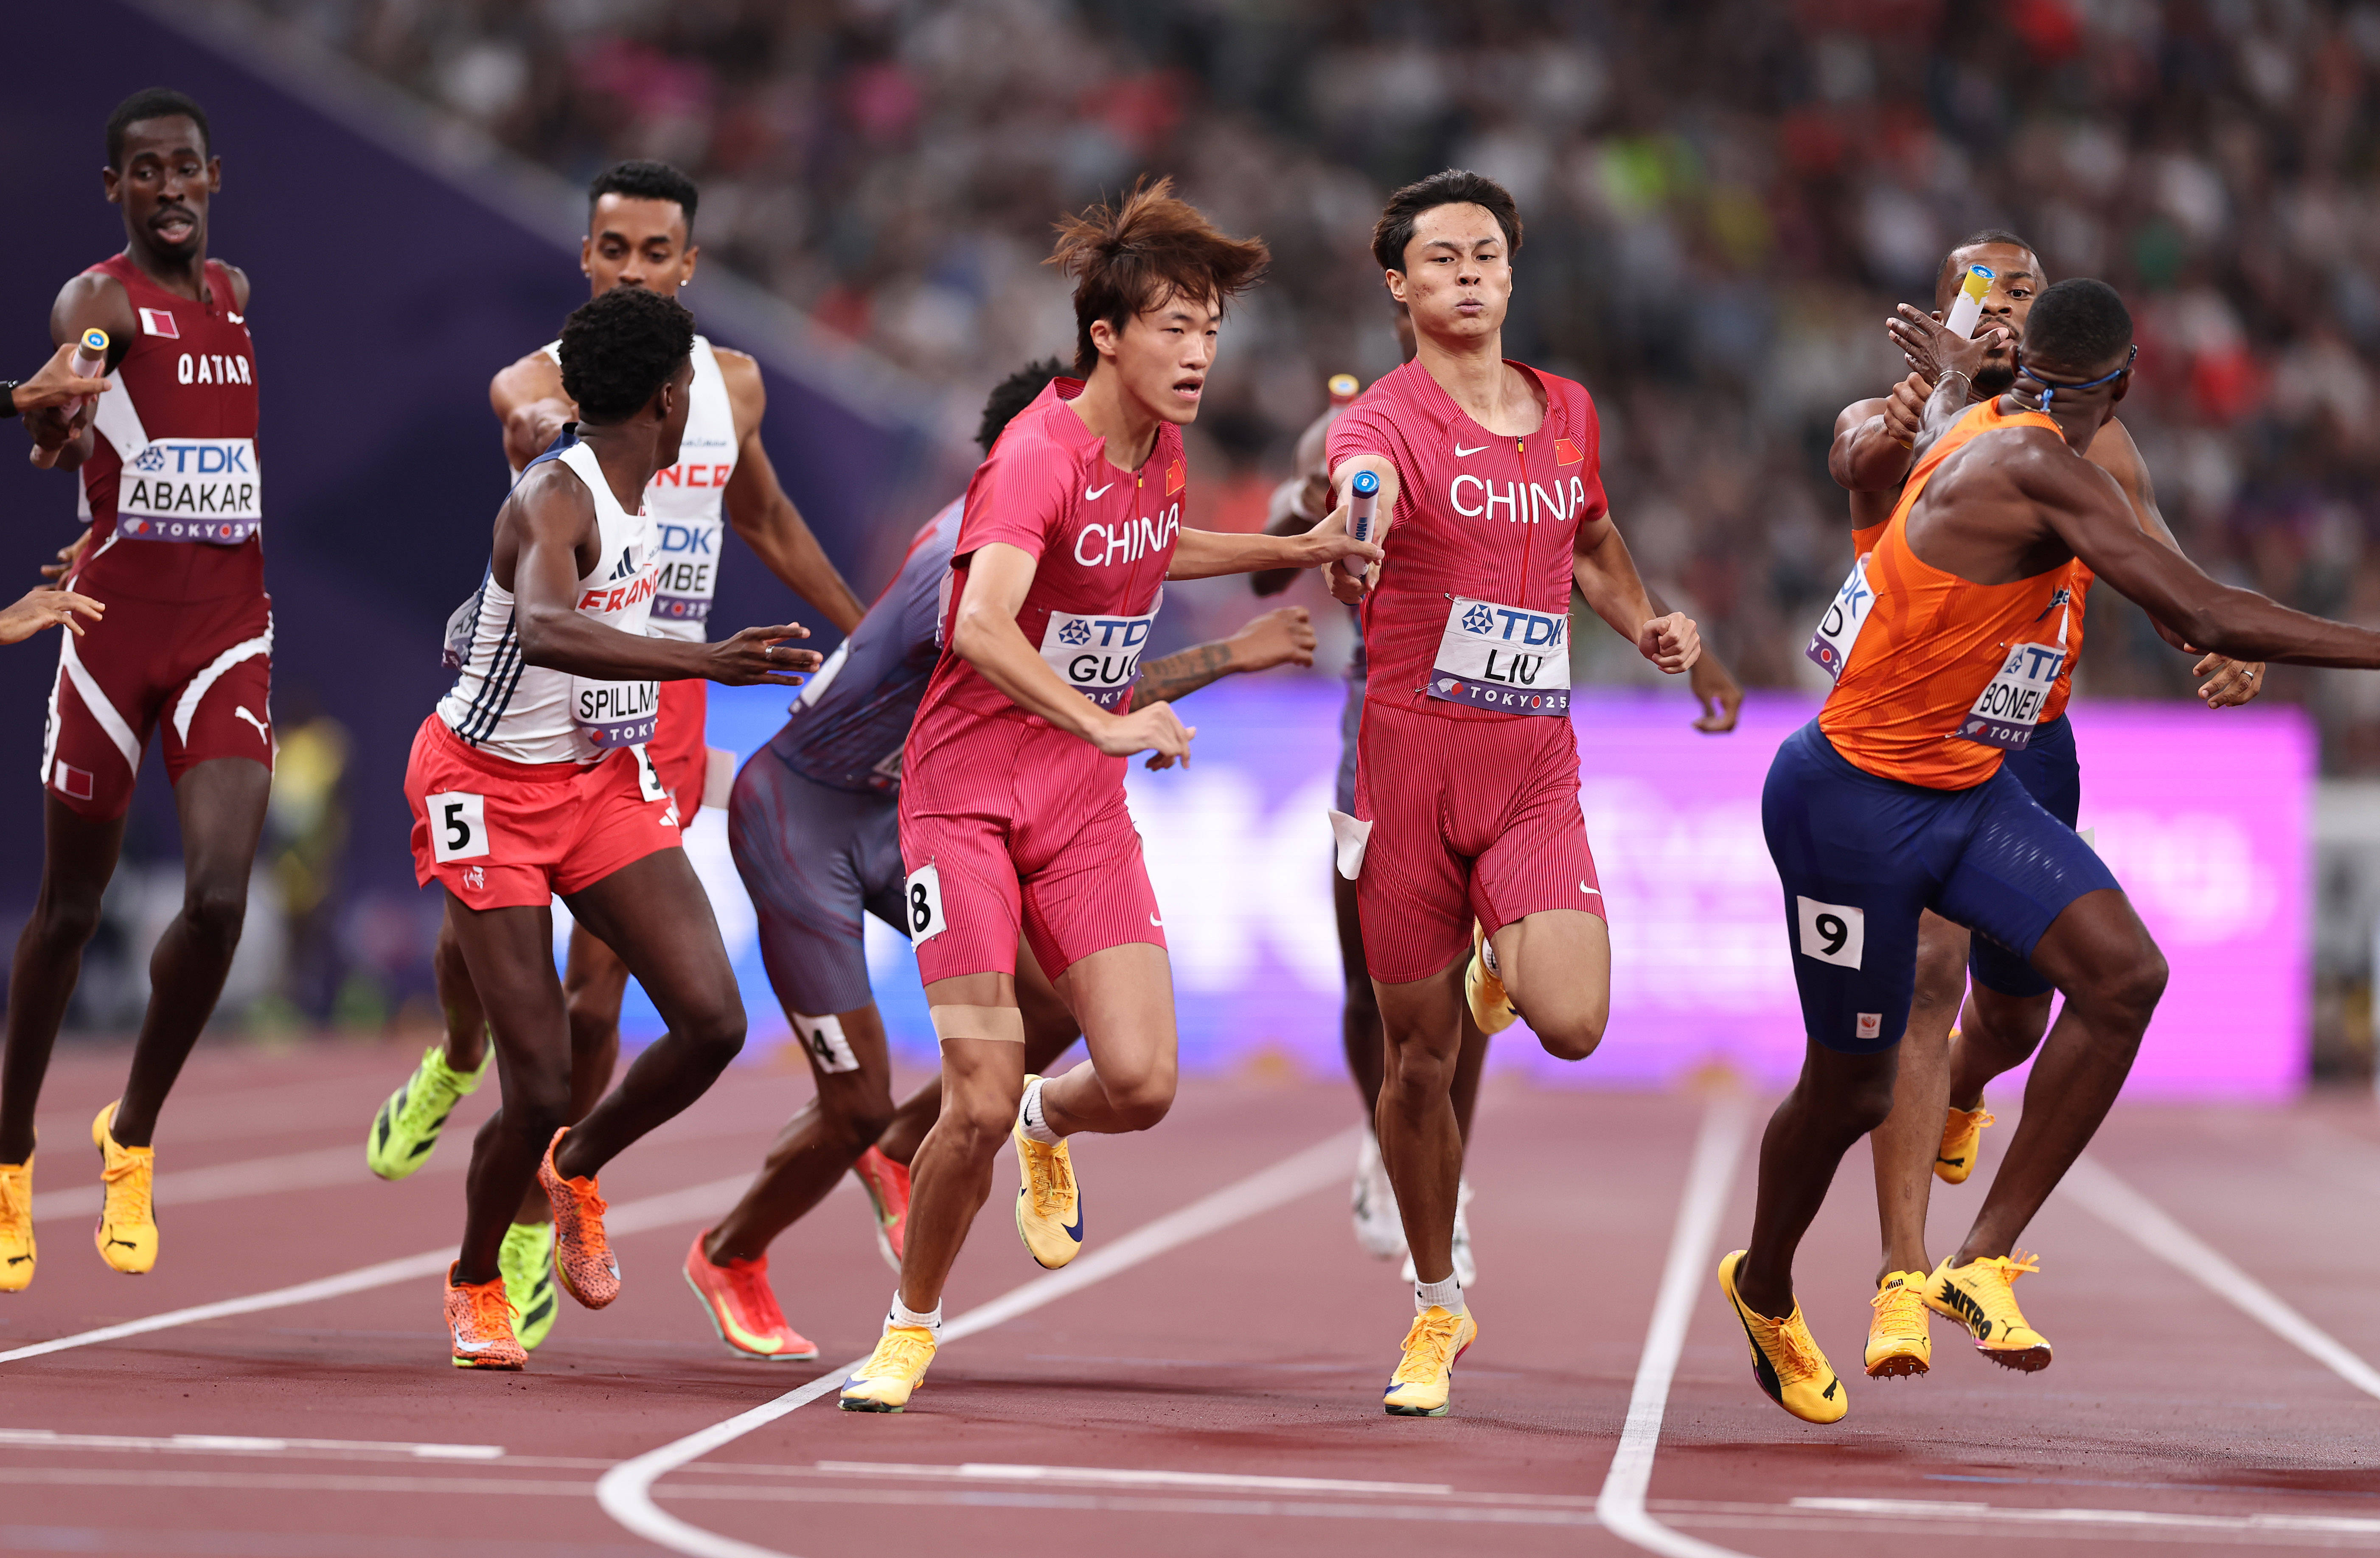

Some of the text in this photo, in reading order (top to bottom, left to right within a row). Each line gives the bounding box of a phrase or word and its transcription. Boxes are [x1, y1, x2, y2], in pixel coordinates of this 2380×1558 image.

[178, 353, 252, 385] QATAR
[167, 445, 248, 474] TDK
[646, 463, 730, 487] NCE
[129, 480, 253, 513] ABAKAR
[1361, 477, 1370, 487] 8
[1450, 474, 1585, 524] CHINA
[657, 522, 714, 554] DK
[1074, 502, 1179, 567] CHINA
[1496, 608, 1567, 647] TDK
[1484, 649, 1543, 685] LIU
[1979, 683, 2047, 721] BONEV
[444, 803, 471, 850] 5
[910, 883, 931, 933] 8
[1816, 913, 1848, 956] 9
[812, 1029, 835, 1064] 4
[1934, 1277, 1993, 1341] NITRO
